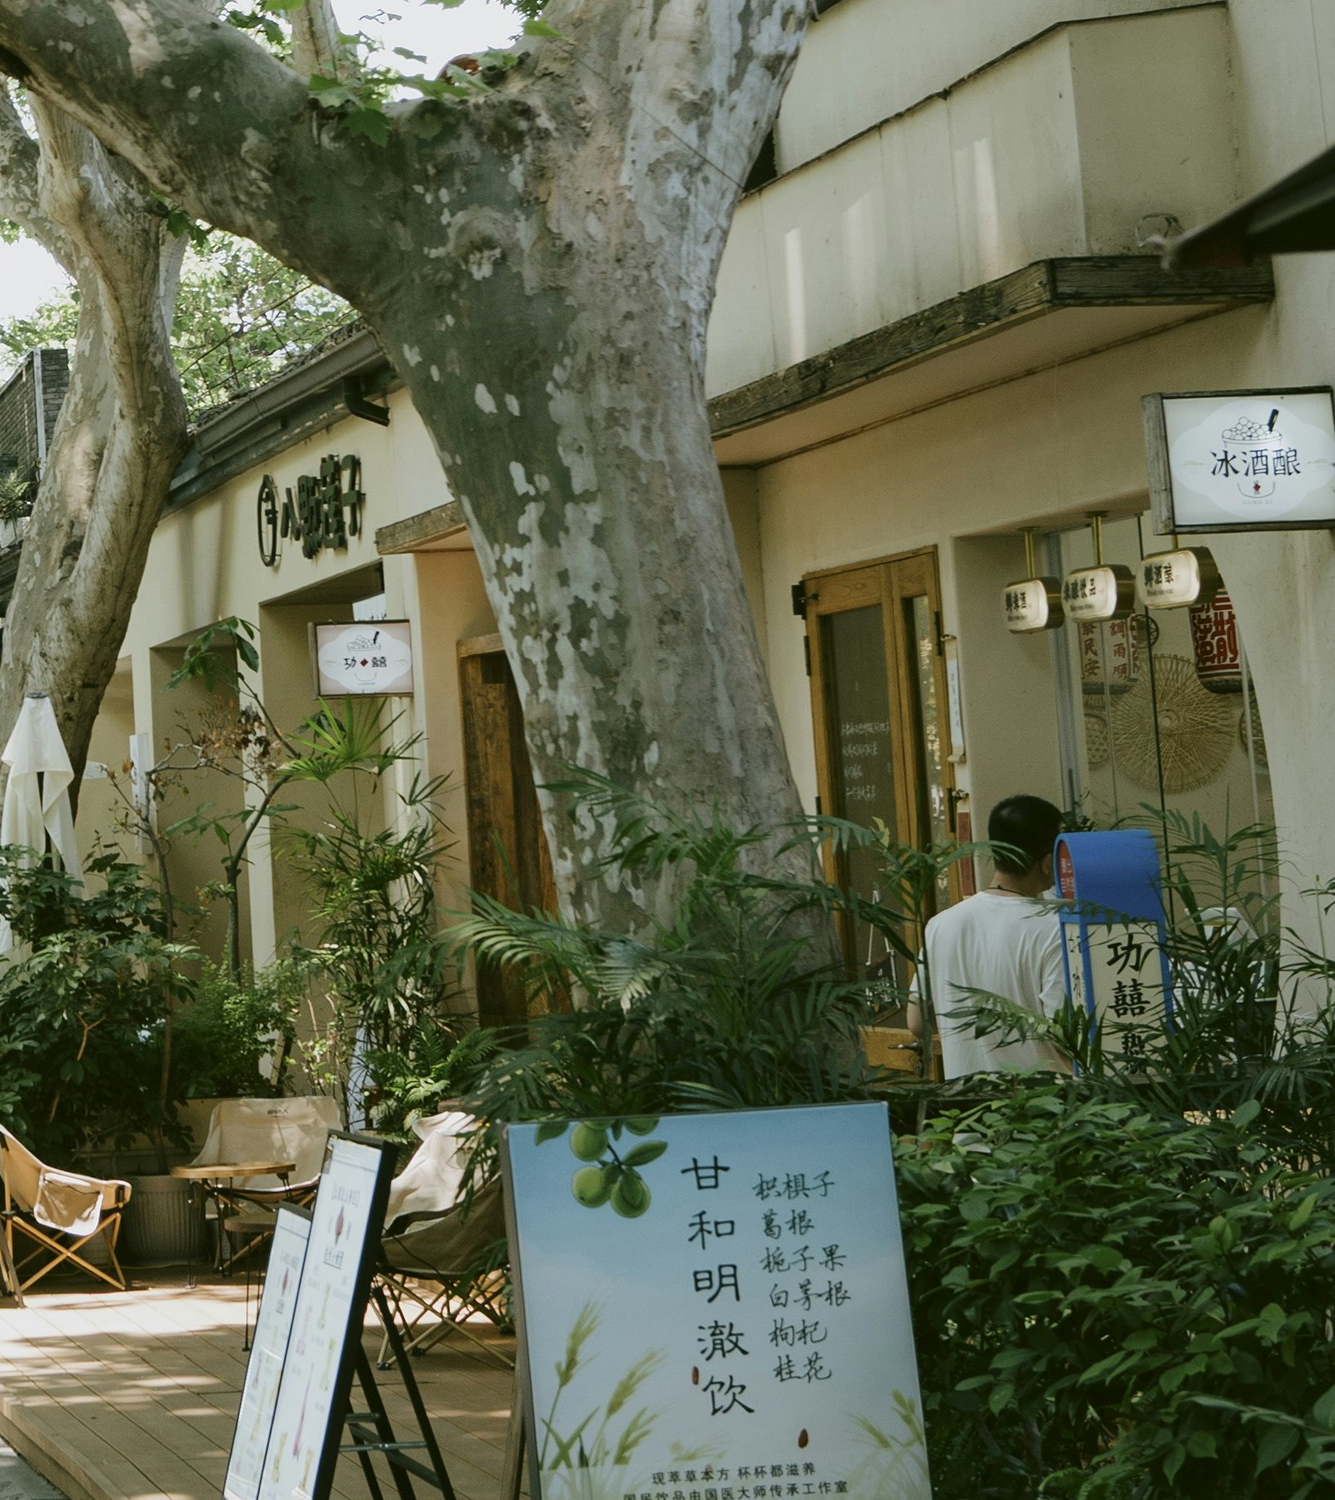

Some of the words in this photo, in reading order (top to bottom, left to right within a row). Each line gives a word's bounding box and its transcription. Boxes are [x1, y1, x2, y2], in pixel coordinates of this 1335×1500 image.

[1210, 447, 1301, 478] 冰酒酿
[761, 1207, 816, 1241] 葛根
[759, 1244, 847, 1275] 栀子果
[680, 1154, 755, 1417] 甘和明澈饮
[769, 1279, 852, 1312] 白茅根
[768, 1317, 828, 1348] 枸杞
[772, 1351, 833, 1384] 桂花
[738, 1461, 816, 1481] 杯杯都滋养
